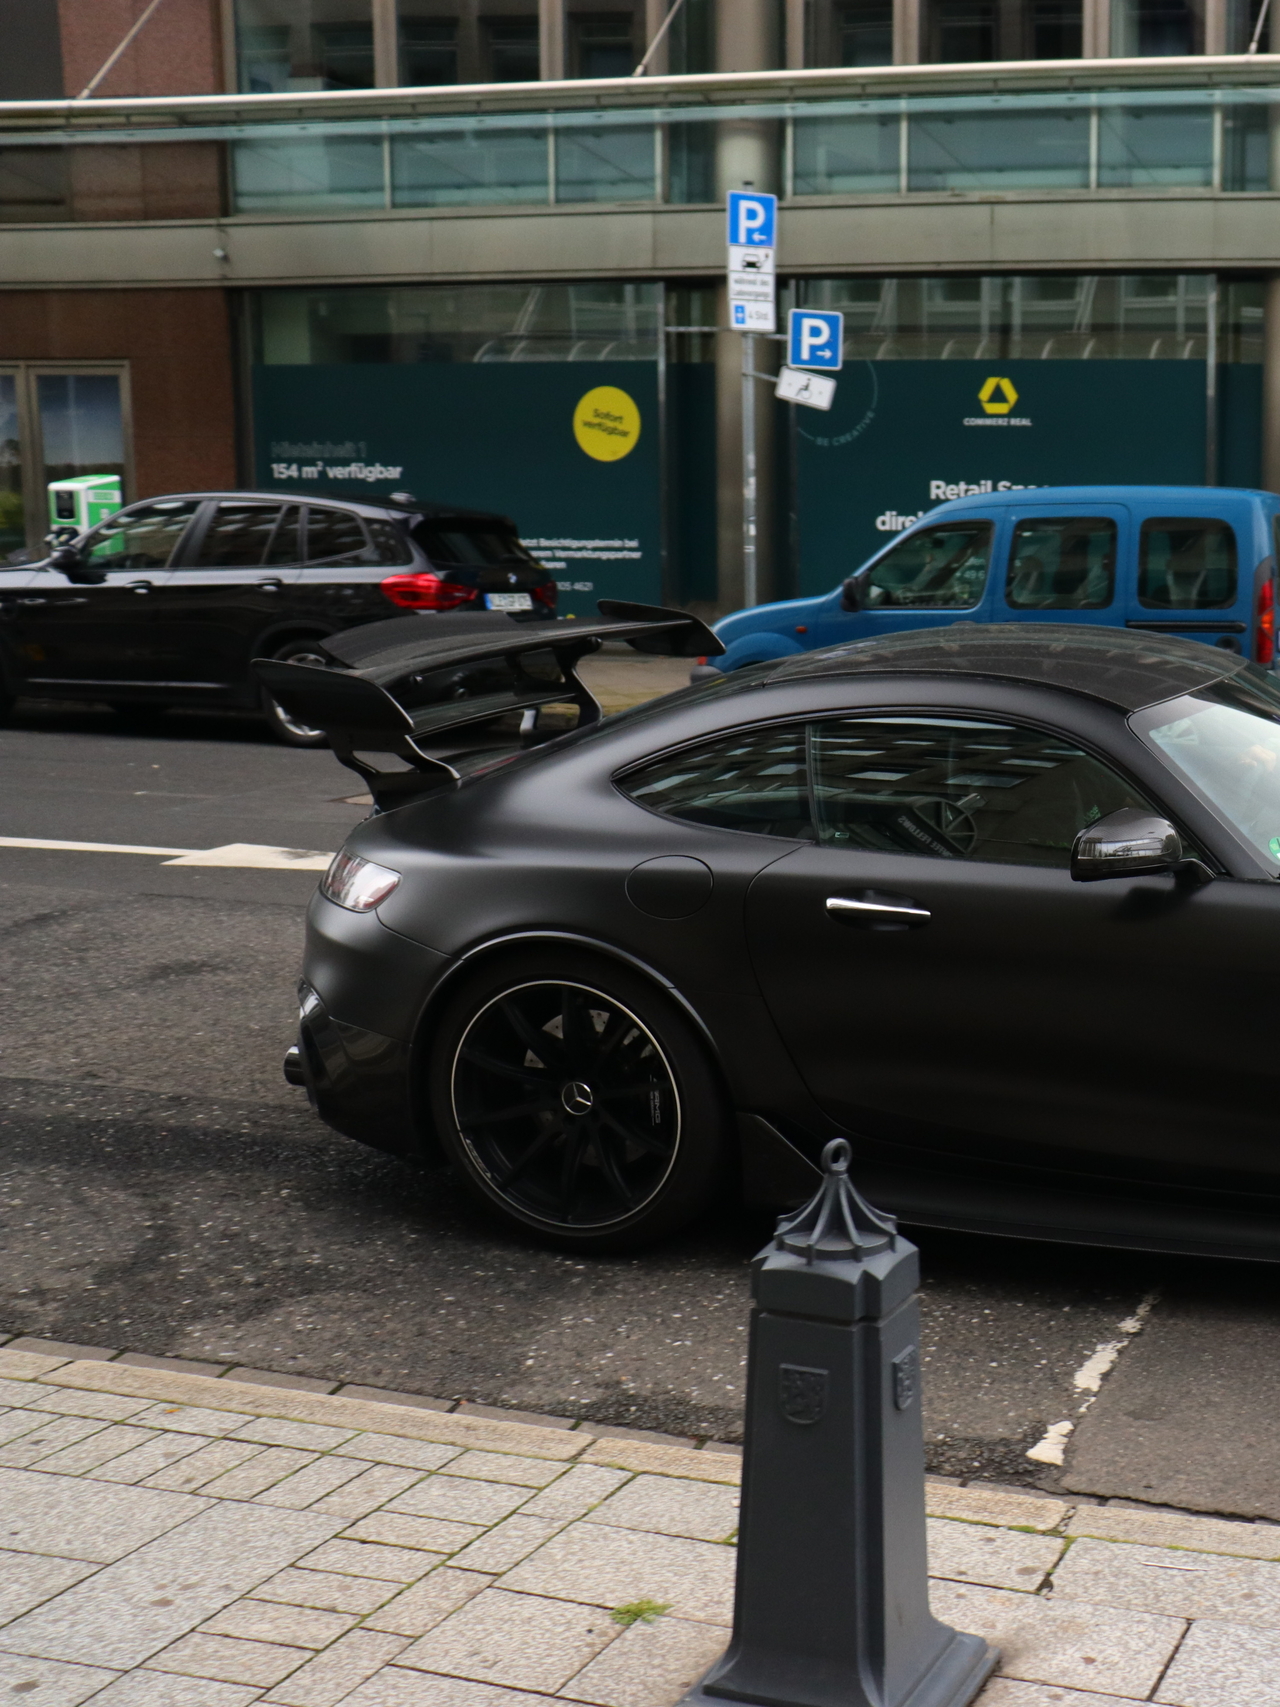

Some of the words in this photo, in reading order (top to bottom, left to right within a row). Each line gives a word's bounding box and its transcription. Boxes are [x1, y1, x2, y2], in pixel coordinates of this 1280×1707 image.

[738, 200, 765, 244] P
[801, 318, 831, 361] P
[1010, 418, 1032, 426] REAL
[271, 463, 299, 479] 154
[325, 462, 403, 482] verfügbar
[930, 480, 993, 500] Retail
